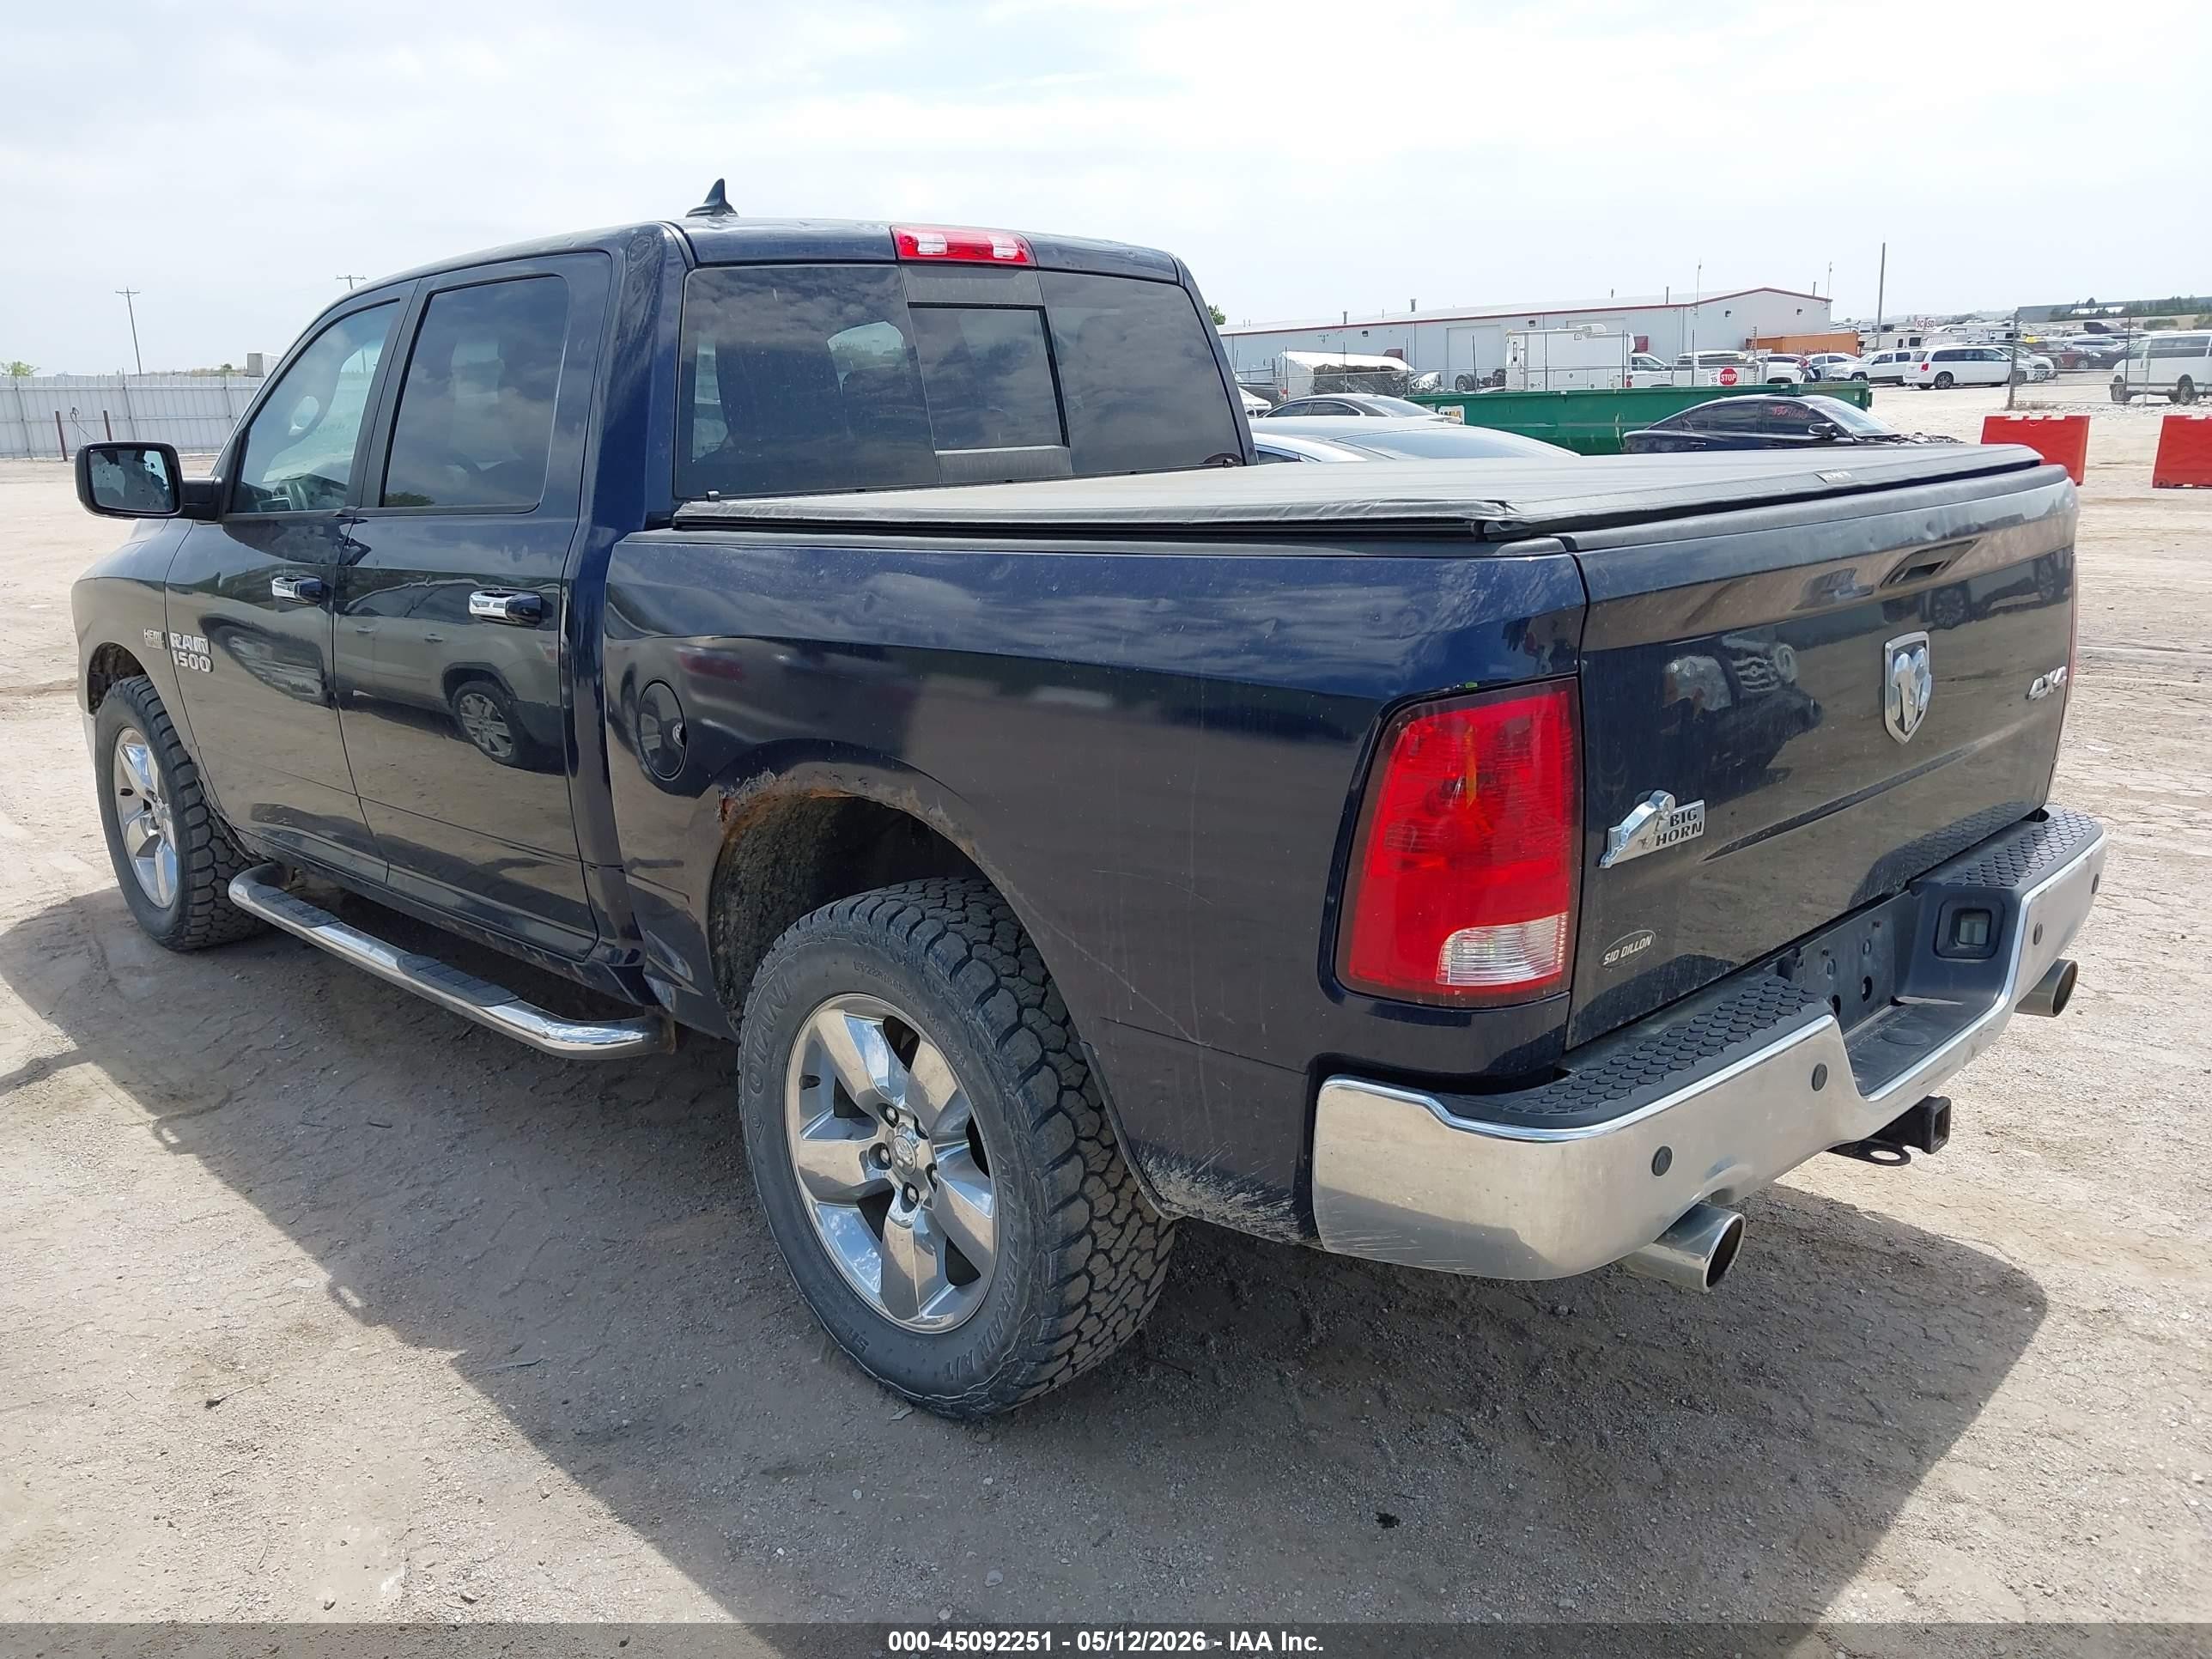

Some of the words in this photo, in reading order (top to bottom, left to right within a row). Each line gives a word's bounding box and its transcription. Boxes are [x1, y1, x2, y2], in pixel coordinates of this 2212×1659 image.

[1720, 374, 1736, 382] STOP
[170, 632, 210, 654] RAM
[173, 650, 212, 673] 1500
[1669, 808, 1697, 828] BIG
[1656, 821, 1703, 847] HORN
[1603, 951, 1620, 965] SID
[1620, 934, 1653, 958] DILLON
